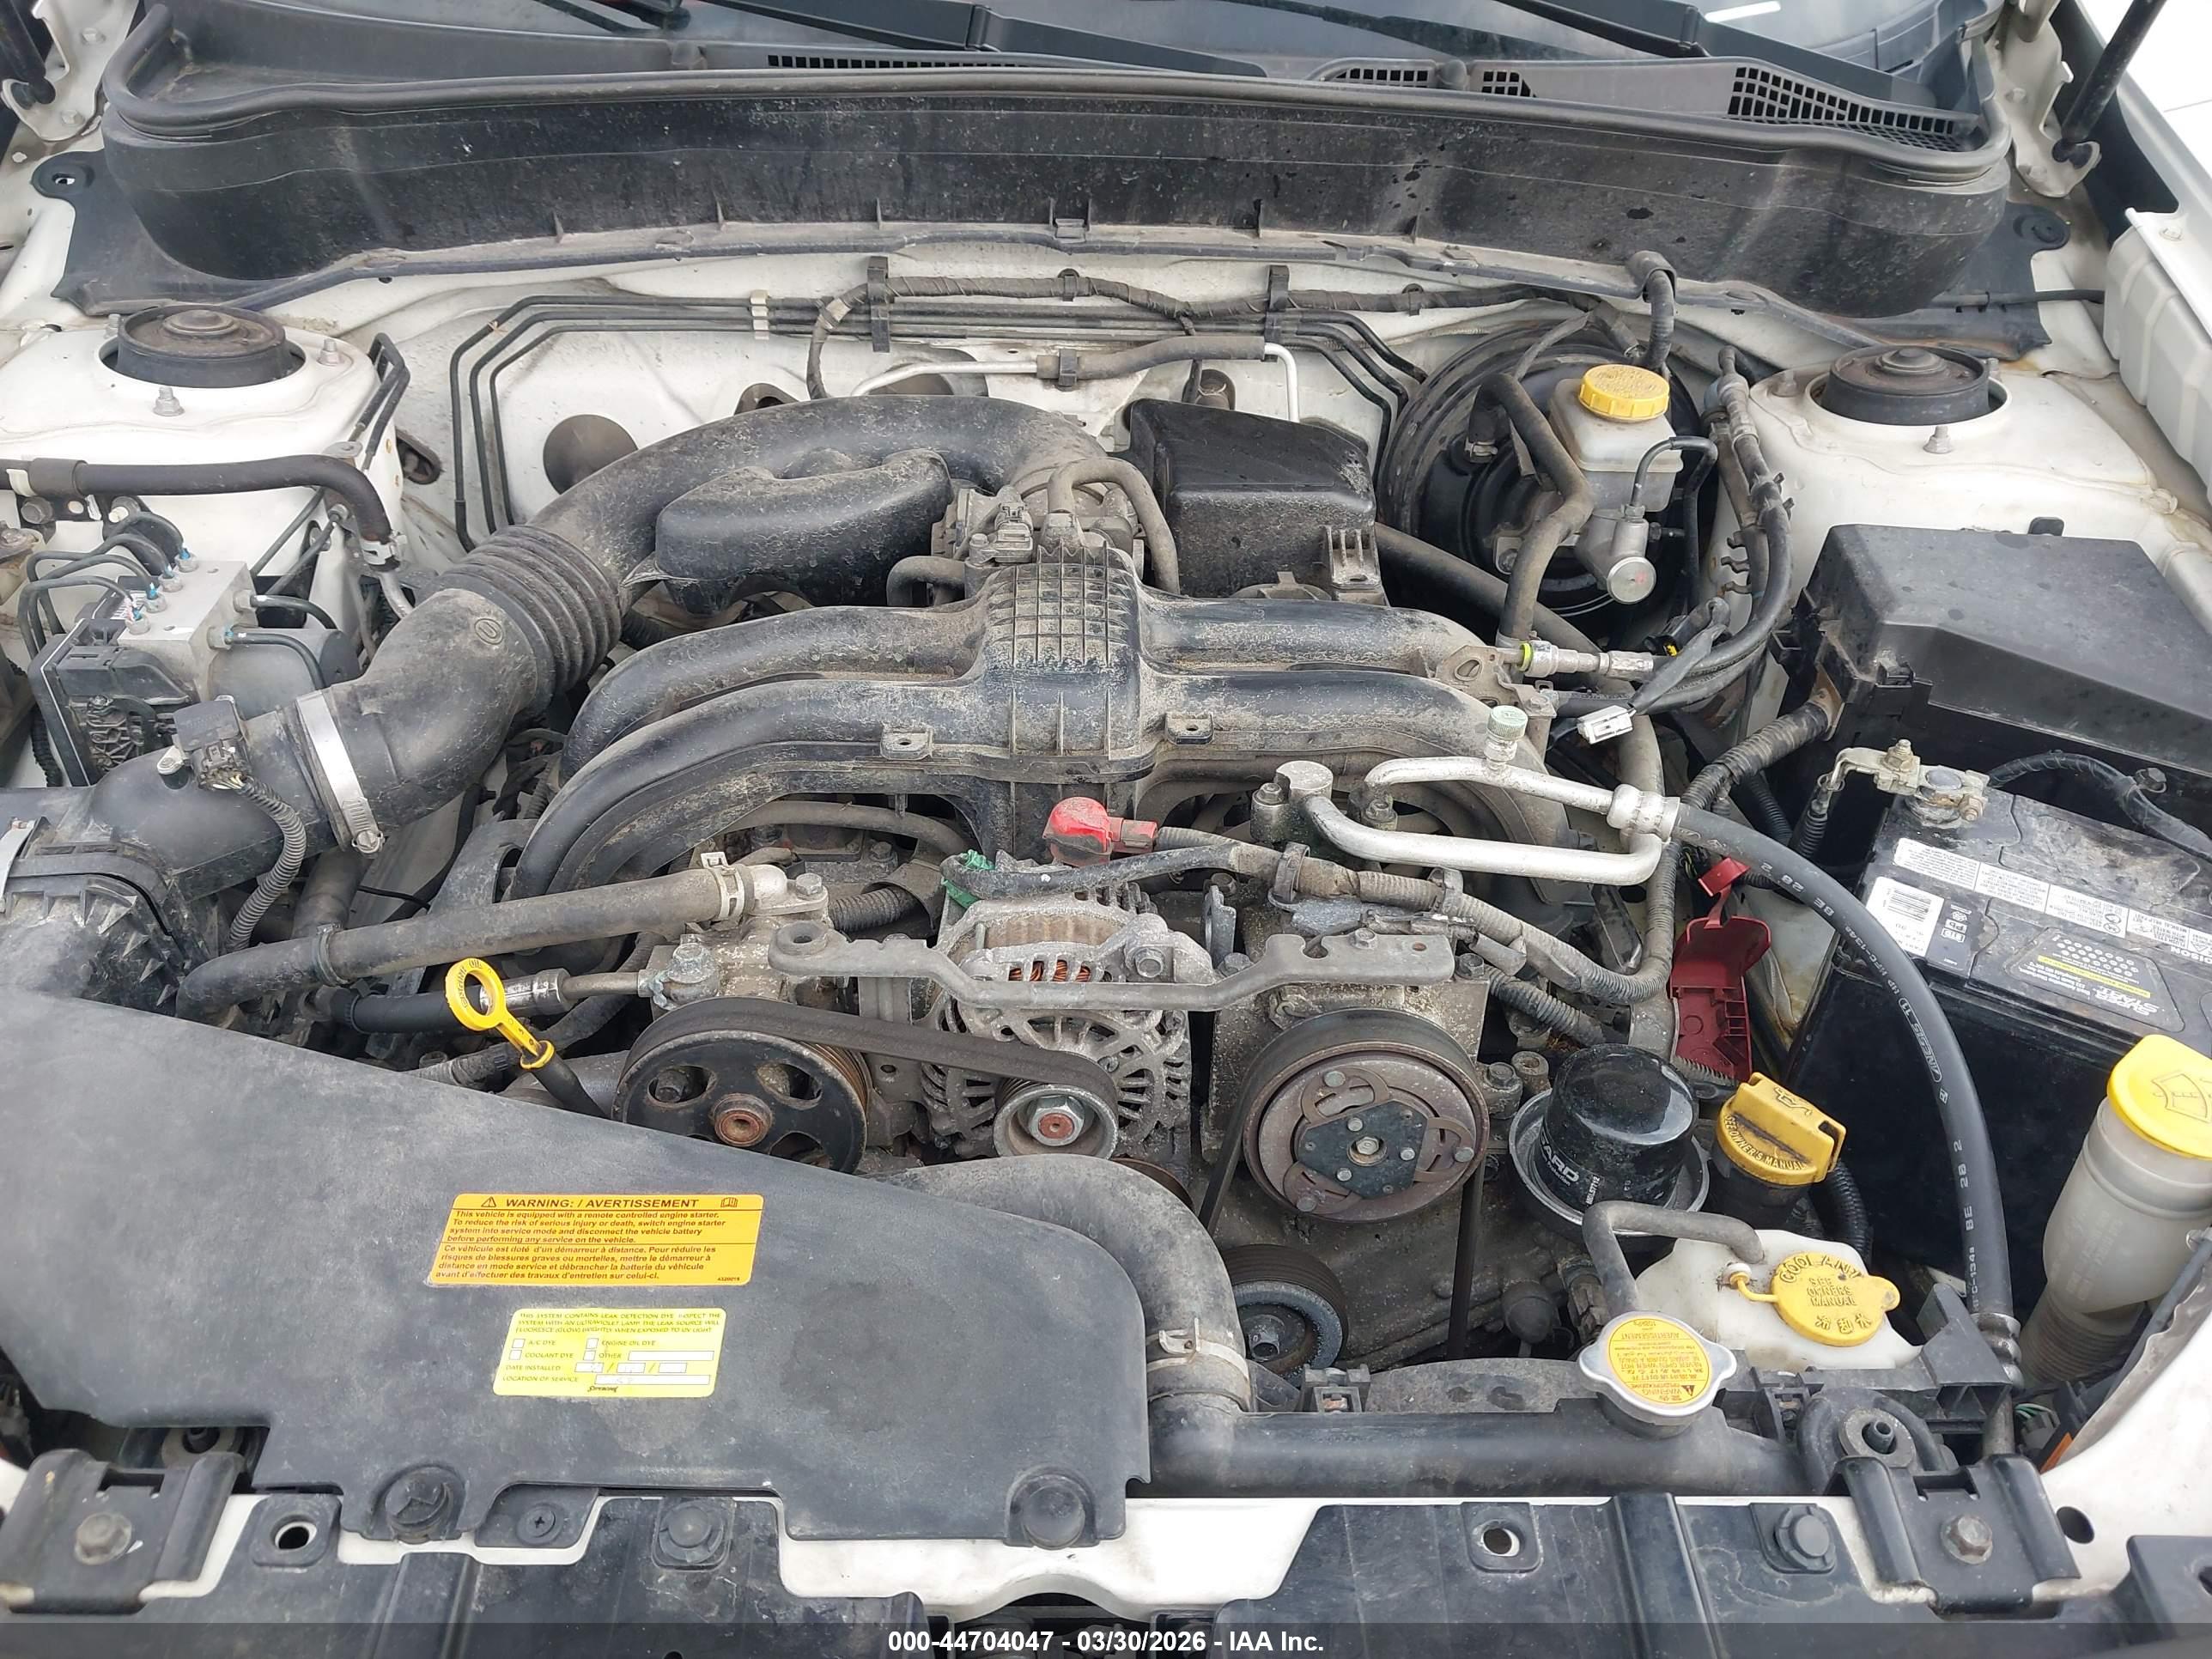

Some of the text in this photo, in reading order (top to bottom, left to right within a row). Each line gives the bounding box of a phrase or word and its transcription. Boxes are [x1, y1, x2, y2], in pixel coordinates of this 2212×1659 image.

[1814, 897, 1835, 916] BE
[2170, 945, 2212, 964] OISON
[1724, 1115, 1806, 1170] SEE OWNER'S MANUAL
[1953, 1139, 1963, 1152] 2
[506, 1199, 574, 1208] WARNING:
[585, 1199, 699, 1208] AVERTISSEMENT
[573, 1219, 597, 1228] injury
[1964, 1205, 1974, 1231] BE
[477, 1236, 523, 1244] performing
[441, 1254, 473, 1262] risques
[1779, 1255, 1863, 1283] COOLANT
[1808, 1277, 1832, 1286] SEE
[1809, 1296, 1857, 1307] MANUAL
